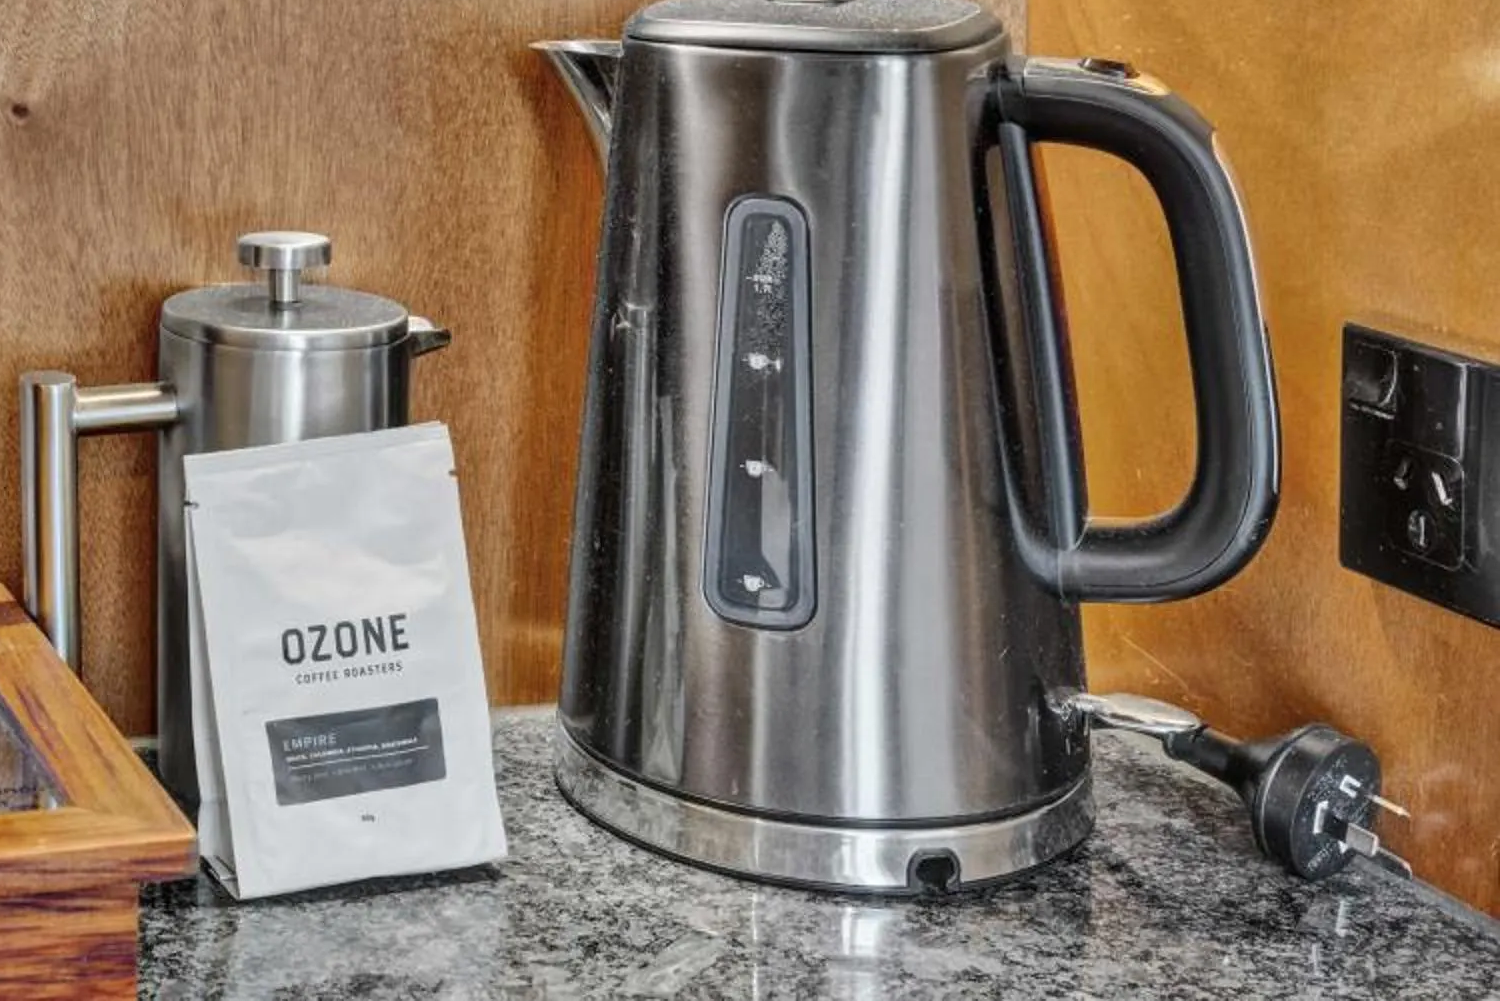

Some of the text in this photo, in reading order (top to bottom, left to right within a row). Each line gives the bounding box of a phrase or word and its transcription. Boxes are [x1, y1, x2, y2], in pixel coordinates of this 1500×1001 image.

[281, 613, 409, 665] OZONE
[295, 661, 403, 684] COFFEE ROASTERS
[284, 733, 337, 752] EMPIRE
